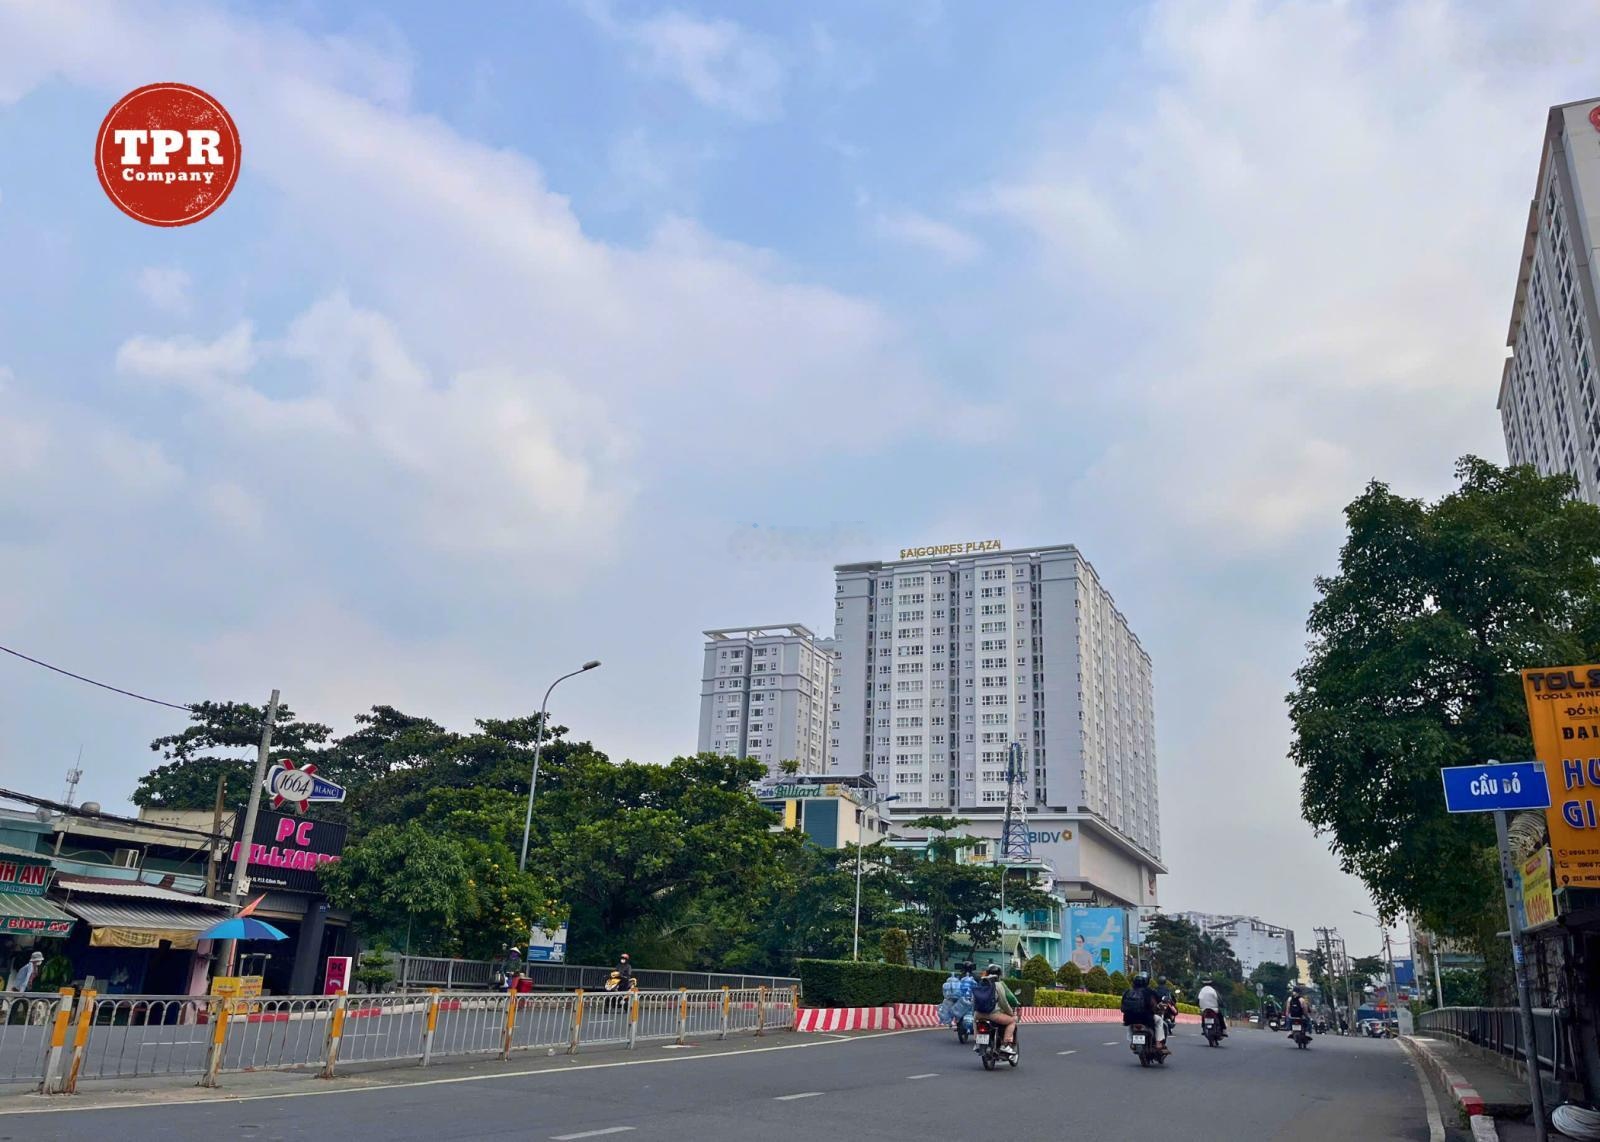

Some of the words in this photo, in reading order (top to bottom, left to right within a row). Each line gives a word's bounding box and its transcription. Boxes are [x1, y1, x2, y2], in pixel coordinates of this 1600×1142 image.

[900, 543, 963, 559] SAIGONRES
[966, 539, 1001, 554] PLAZA
[1535, 692, 1573, 700] TOOLS
[279, 773, 311, 796] 1664
[314, 785, 338, 797] BLANC
[757, 788, 774, 797] Café
[774, 784, 821, 798] Billiard
[1470, 772, 1498, 796] CẦU
[1562, 799, 1600, 829] GI
[275, 817, 314, 846] PC
[1028, 831, 1061, 843] BIDV
[18, 864, 47, 886] AN
[8, 918, 46, 930] BÌNH
[48, 920, 71, 932] AN
